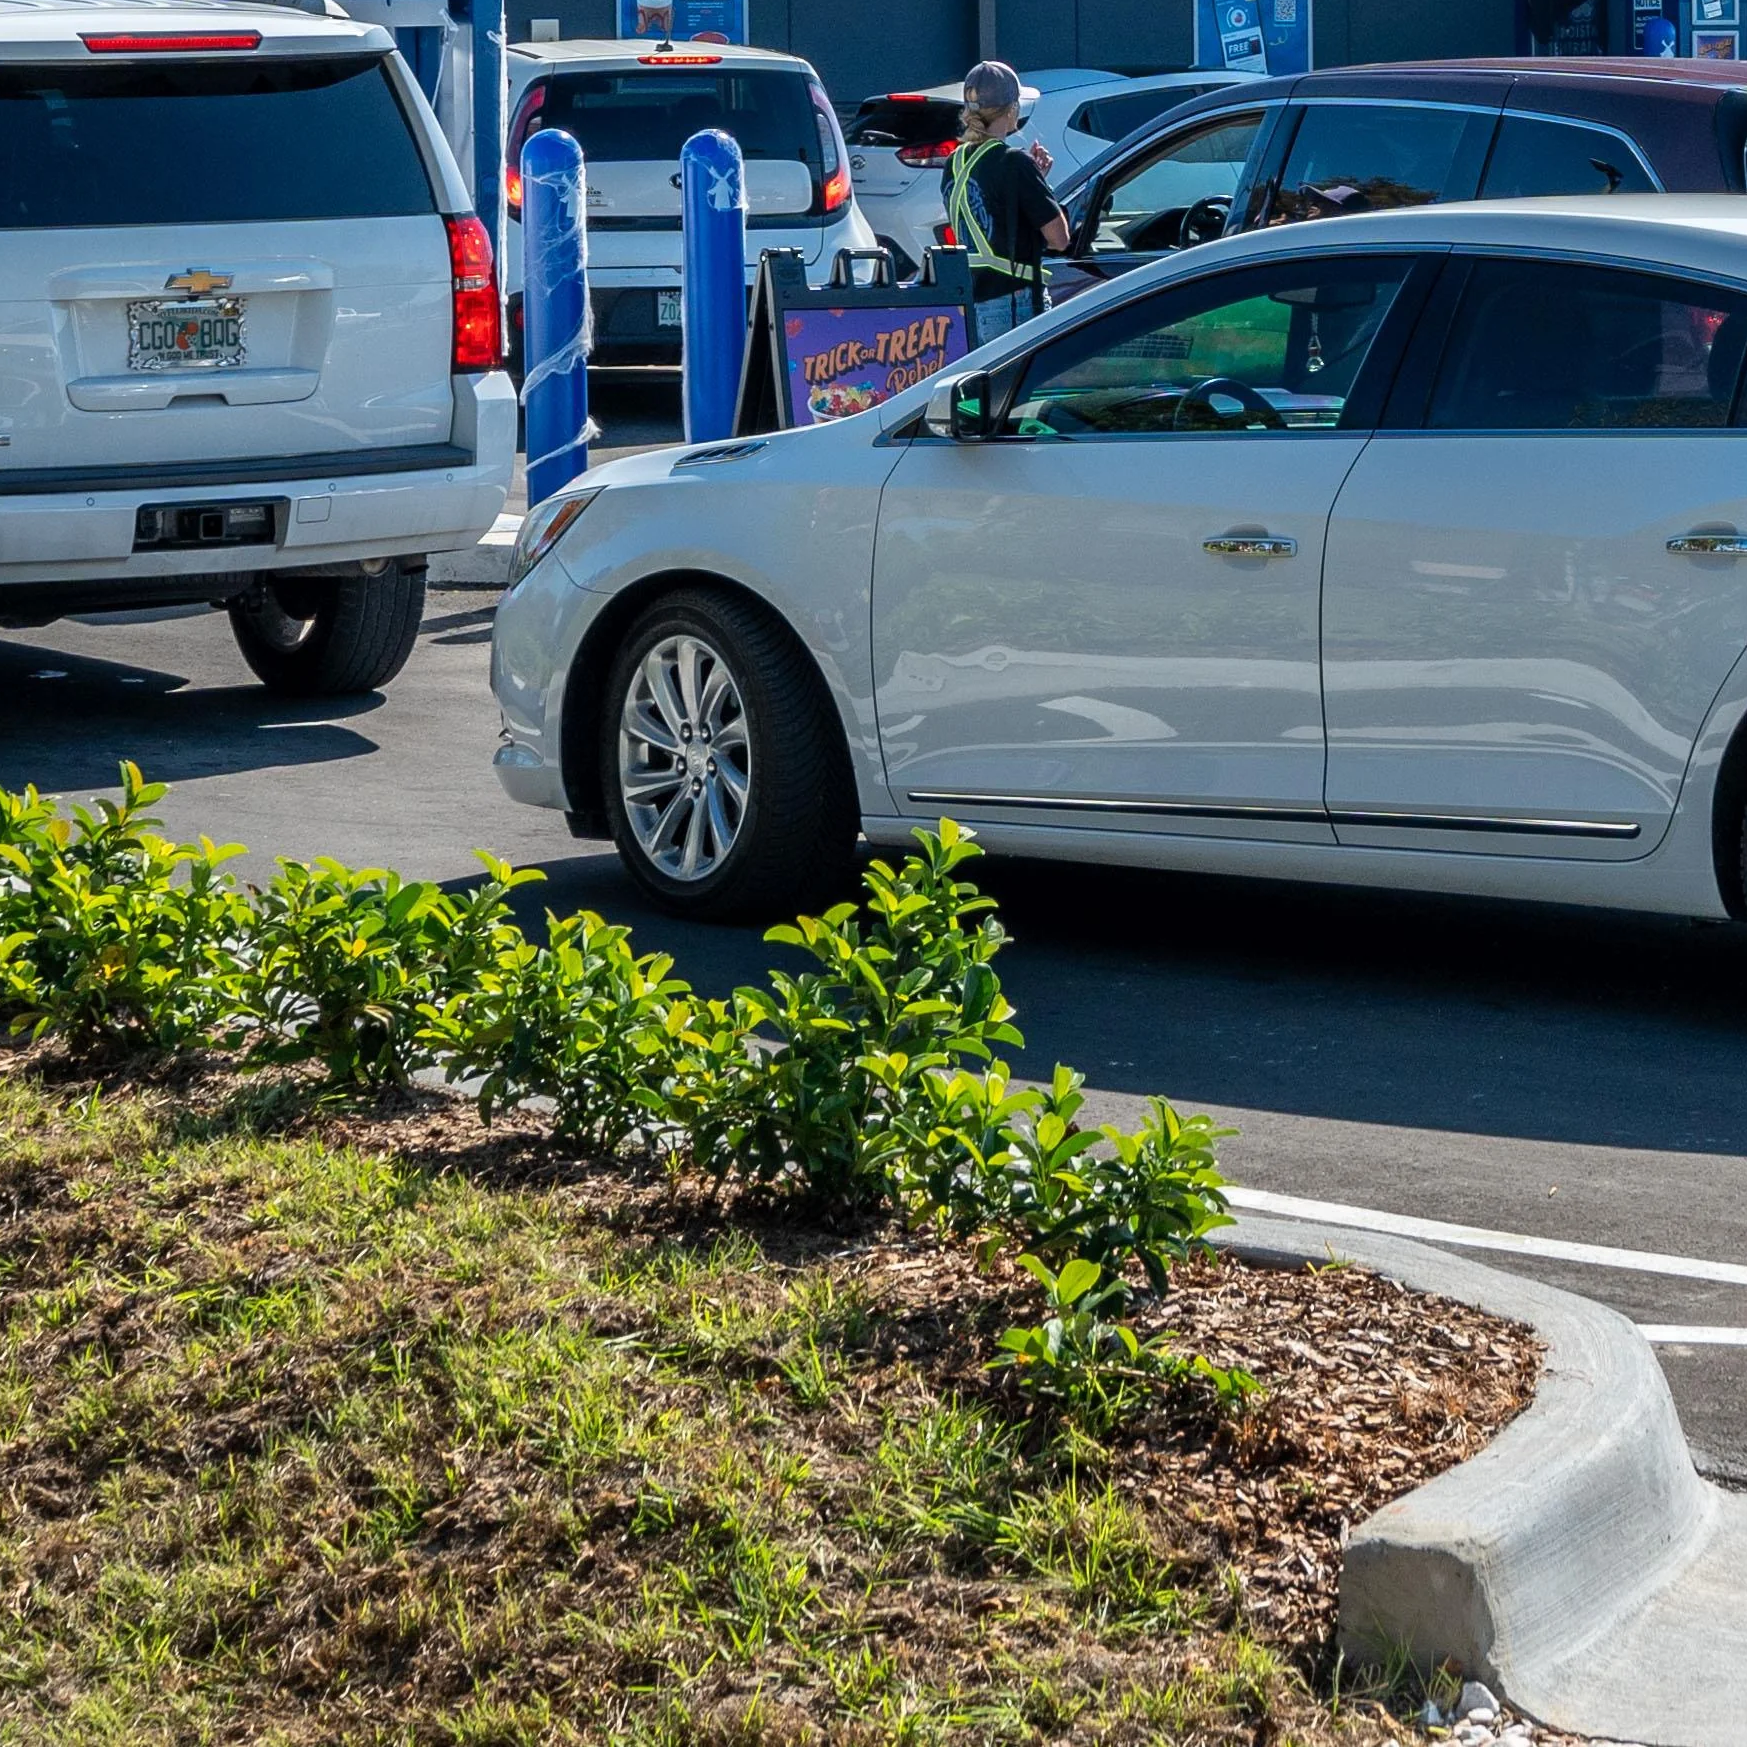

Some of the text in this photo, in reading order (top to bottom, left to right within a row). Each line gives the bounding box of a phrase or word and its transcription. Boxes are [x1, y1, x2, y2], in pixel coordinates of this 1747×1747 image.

[1228, 41, 1250, 55] FREE
[804, 315, 951, 382] TRICK OR TREAT
